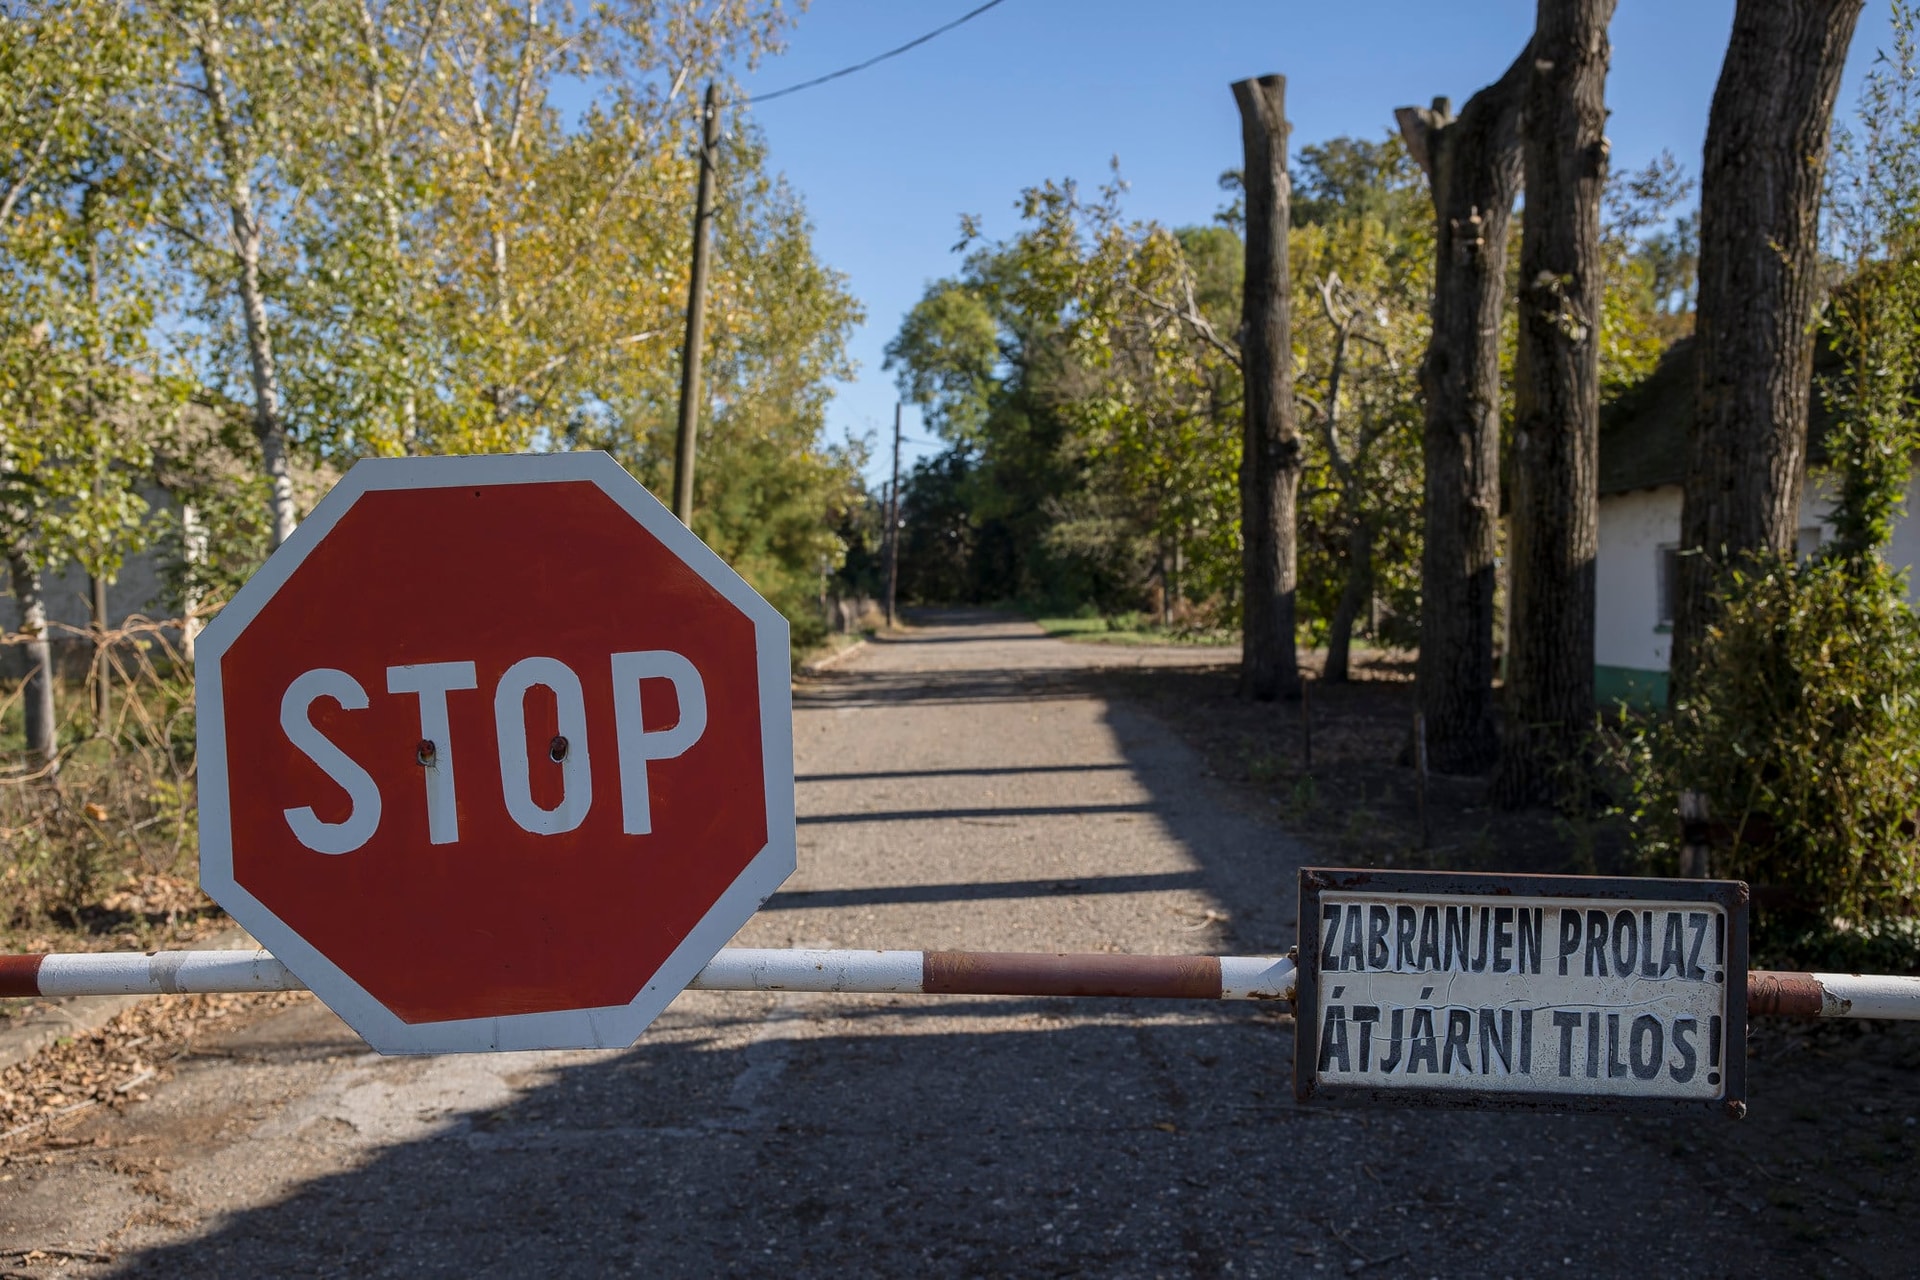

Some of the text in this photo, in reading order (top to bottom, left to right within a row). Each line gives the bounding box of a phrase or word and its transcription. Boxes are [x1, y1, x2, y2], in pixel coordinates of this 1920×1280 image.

[280, 650, 707, 855] STOP
[1321, 903, 1725, 984] ZABRANJEN PROLAZ!
[1318, 985, 1721, 1085] ÁTJÁRNI TILOS!
